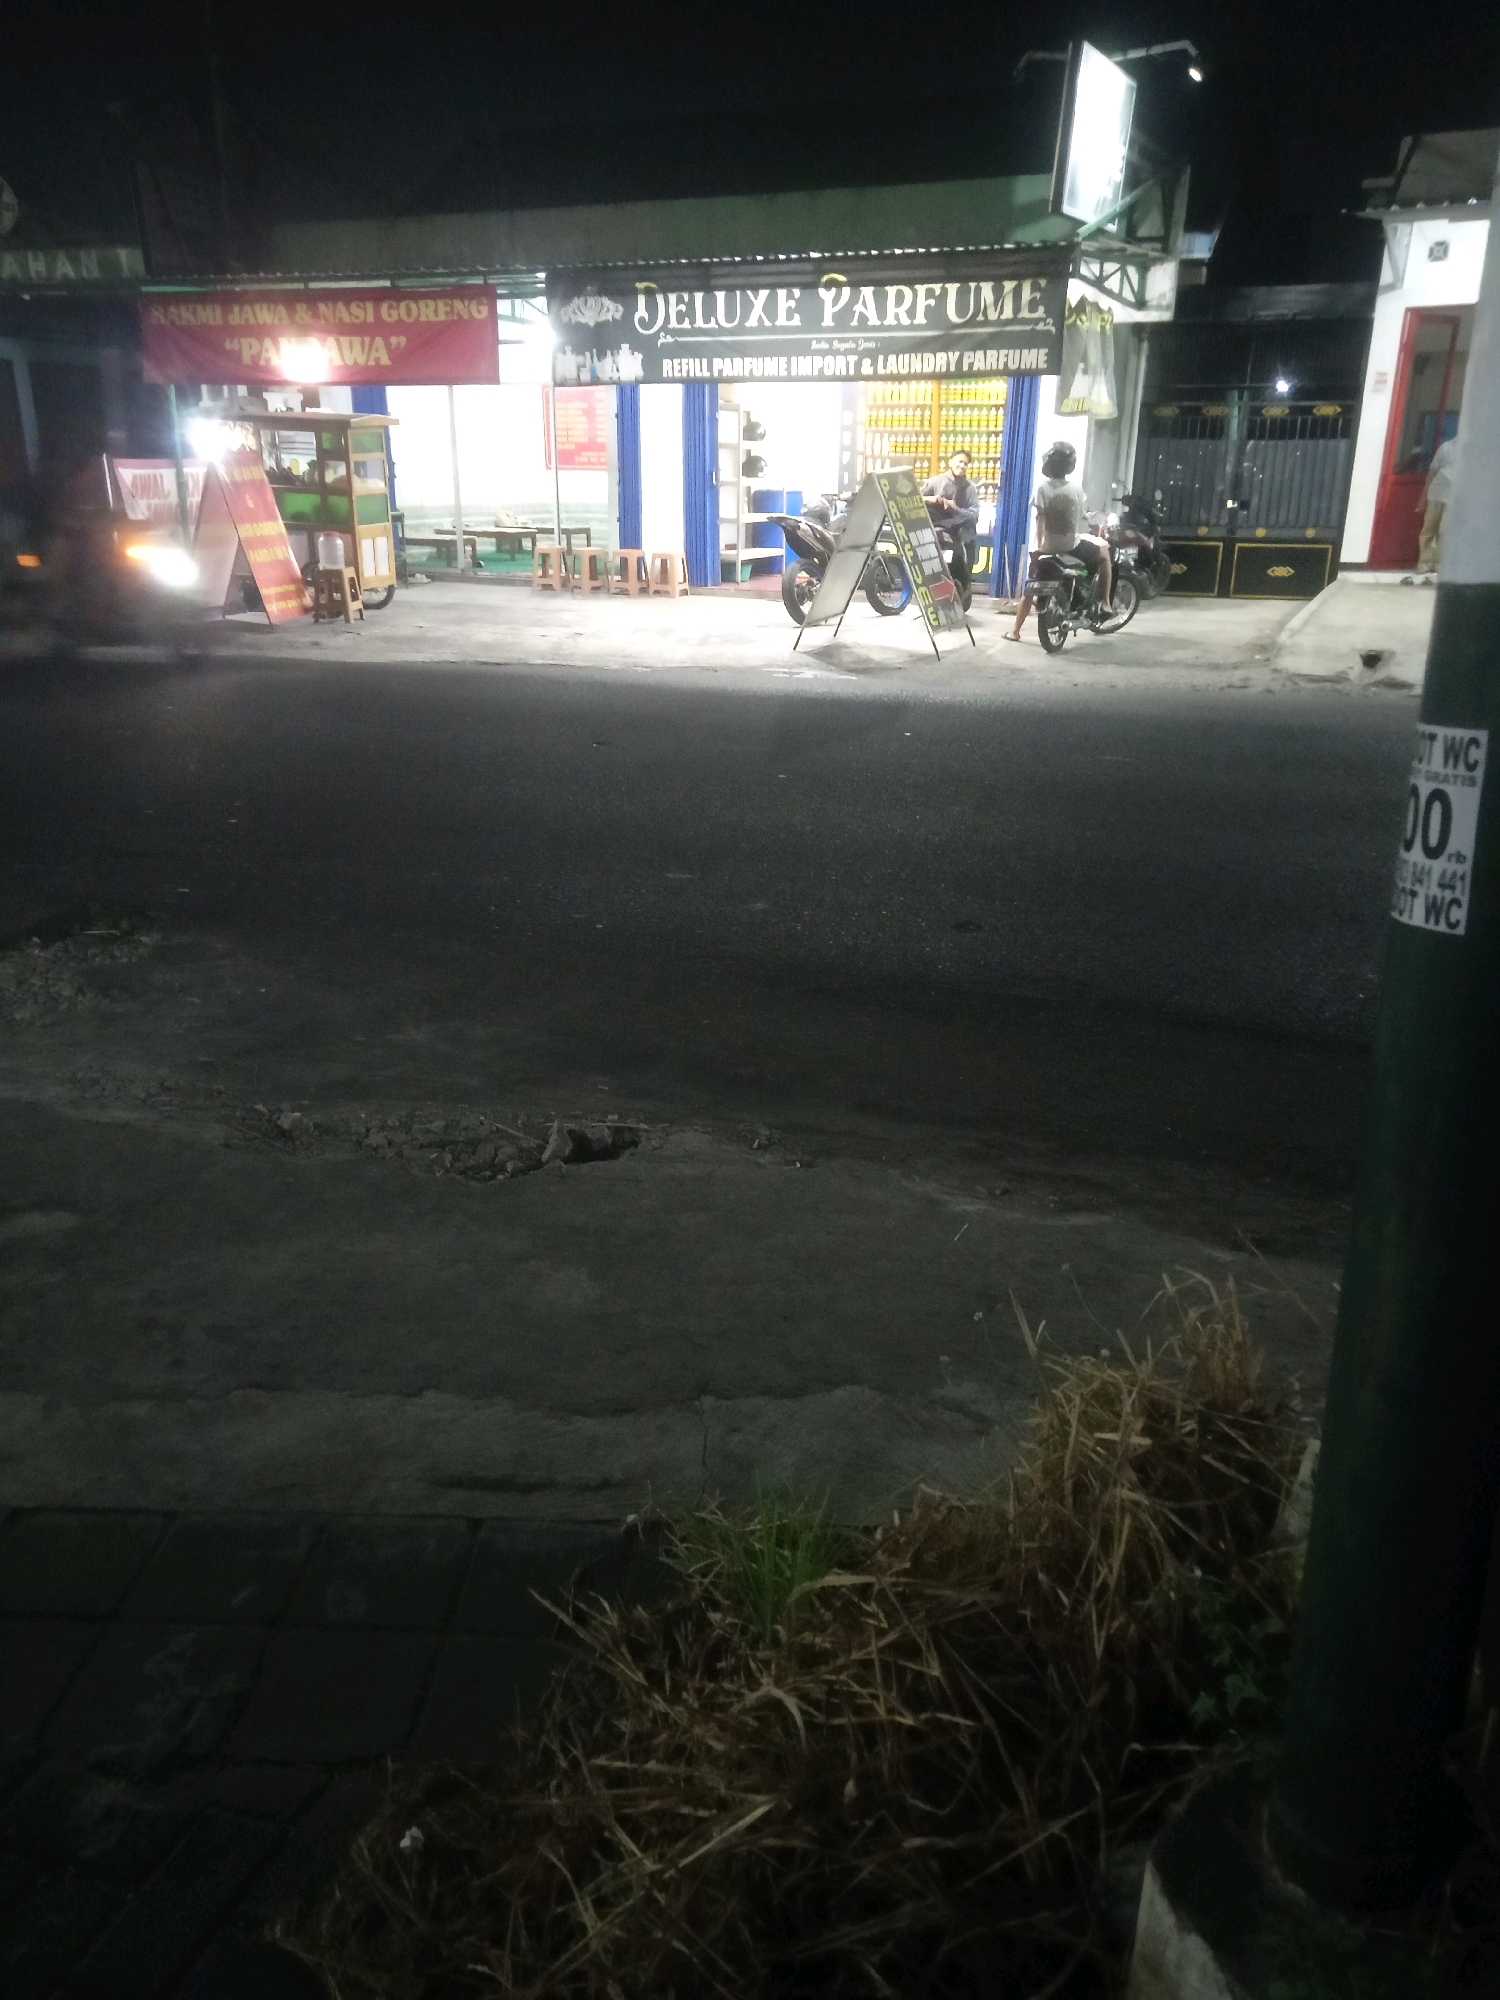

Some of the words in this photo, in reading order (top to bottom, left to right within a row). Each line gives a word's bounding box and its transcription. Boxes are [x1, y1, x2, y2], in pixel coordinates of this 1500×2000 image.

[228, 303, 290, 326] JAWA
[295, 303, 312, 324] &
[317, 300, 375, 324] NASI
[380, 297, 489, 323] GORENG
[634, 281, 802, 335] DELUXE
[817, 272, 1048, 328] PARFUME
[662, 357, 711, 378] REFILL
[712, 356, 788, 377] PARFUME
[790, 355, 858, 376] IMPORT
[860, 357, 874, 375] &
[877, 351, 960, 375] LAUNDRY
[962, 349, 1049, 371] PARFUME
[1443, 734, 1481, 773] WC
[1425, 892, 1463, 931] WC
